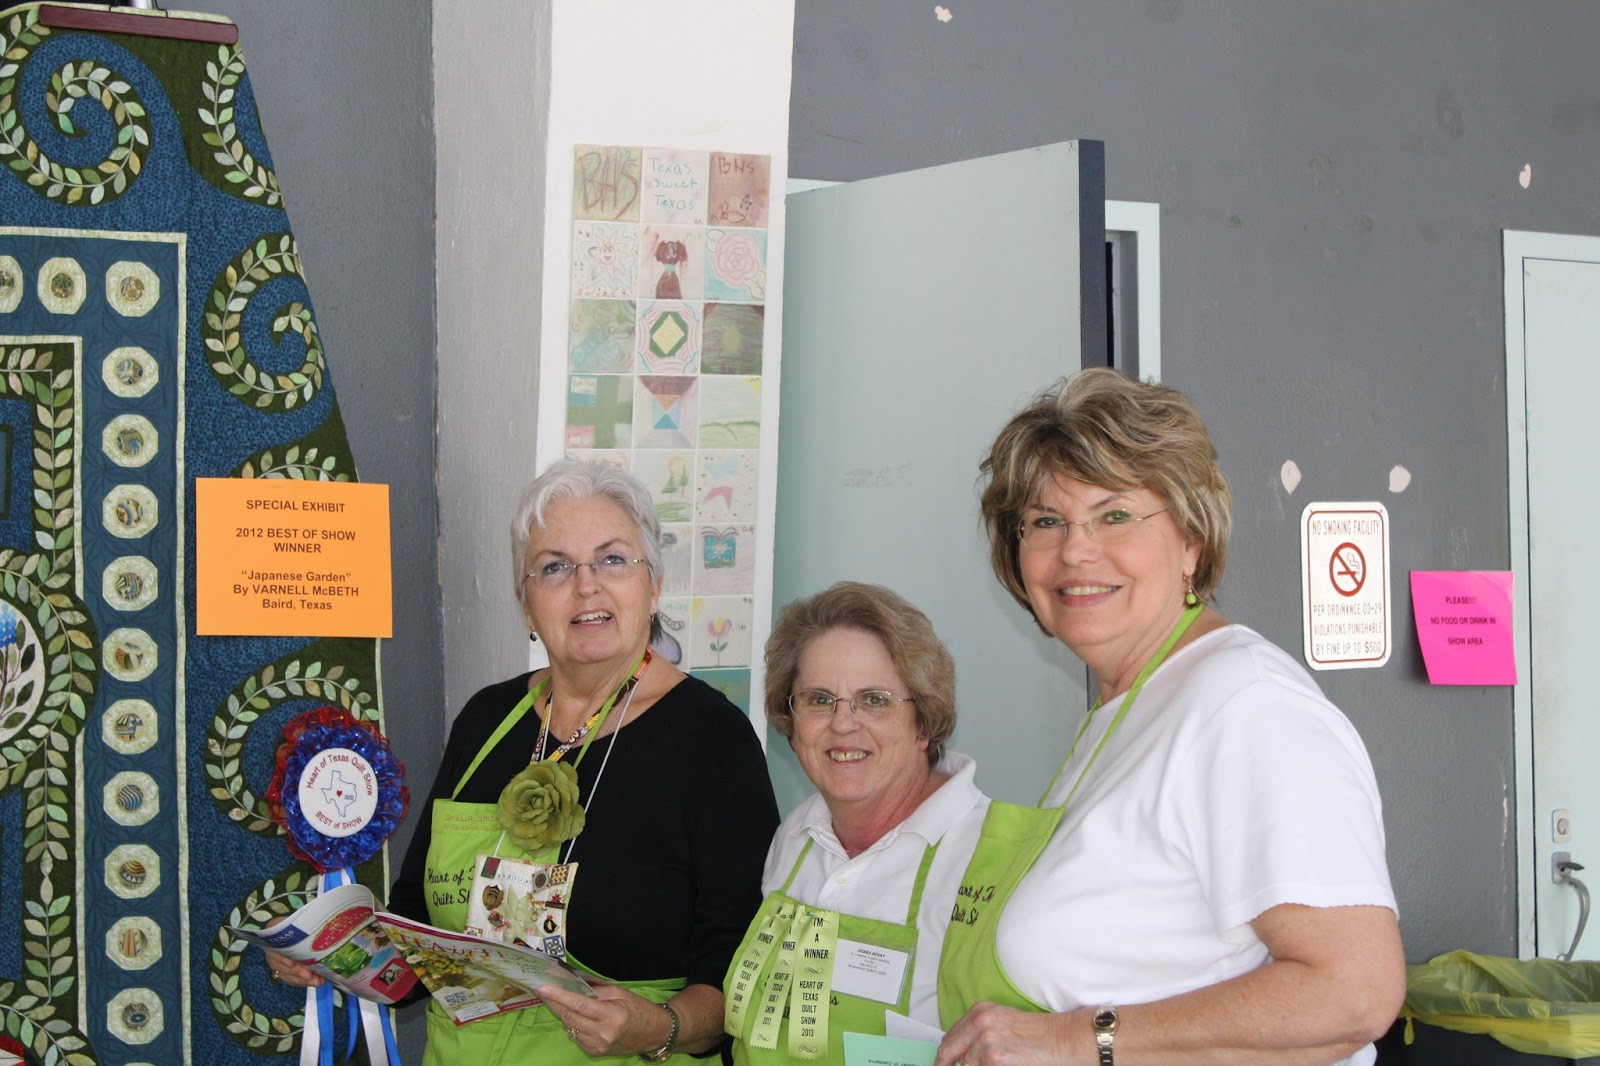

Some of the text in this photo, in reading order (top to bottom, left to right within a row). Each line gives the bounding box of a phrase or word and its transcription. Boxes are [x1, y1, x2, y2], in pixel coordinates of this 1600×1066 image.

[649, 157, 692, 175] Texas
[653, 194, 694, 211] Texas
[246, 499, 345, 513] SPECIAL EXHIBIT
[1312, 519, 1379, 536] NO SMOKING FACILITY
[236, 527, 356, 541] 2012 BEST OF SHOW
[274, 542, 321, 554] WINNER
[233, 584, 359, 597] By VARNELL McBETH
[262, 599, 332, 611] Baird, Texas
[1313, 602, 1382, 617] PER ORDINANCE 03-29
[1430, 617, 1496, 625] NO FOOD OR DRINK IN
[1314, 622, 1382, 636] VIOLATIONS PUNISHABLE
[1447, 637, 1484, 646] SHOW AREA
[1315, 644, 1325, 655] BY
[1327, 643, 1341, 655] FINE
[1343, 643, 1351, 654] UP
[1353, 643, 1362, 654] TO
[306, 754, 373, 796] Heart of Texas Quilt Show
[315, 811, 332, 827] BEST
[342, 816, 363, 830] SHOW
[427, 868, 450, 884] Heart
[452, 869, 465, 886] of
[432, 890, 455, 908] Quilt
[814, 933, 819, 943] A
[804, 949, 829, 960] WINNER
[742, 959, 754, 969] HEART
[740, 971, 752, 981] TEXAS
[774, 972, 784, 980] HEART
[771, 983, 784, 992] TEXAS
[799, 981, 824, 990] HEART OF
[802, 993, 819, 1001] TEXAS
[764, 1006, 776, 1014] SHOW
[801, 1005, 817, 1013] QUILT
[800, 1017, 817, 1025] SHOW
[801, 1029, 814, 1037] 2013
